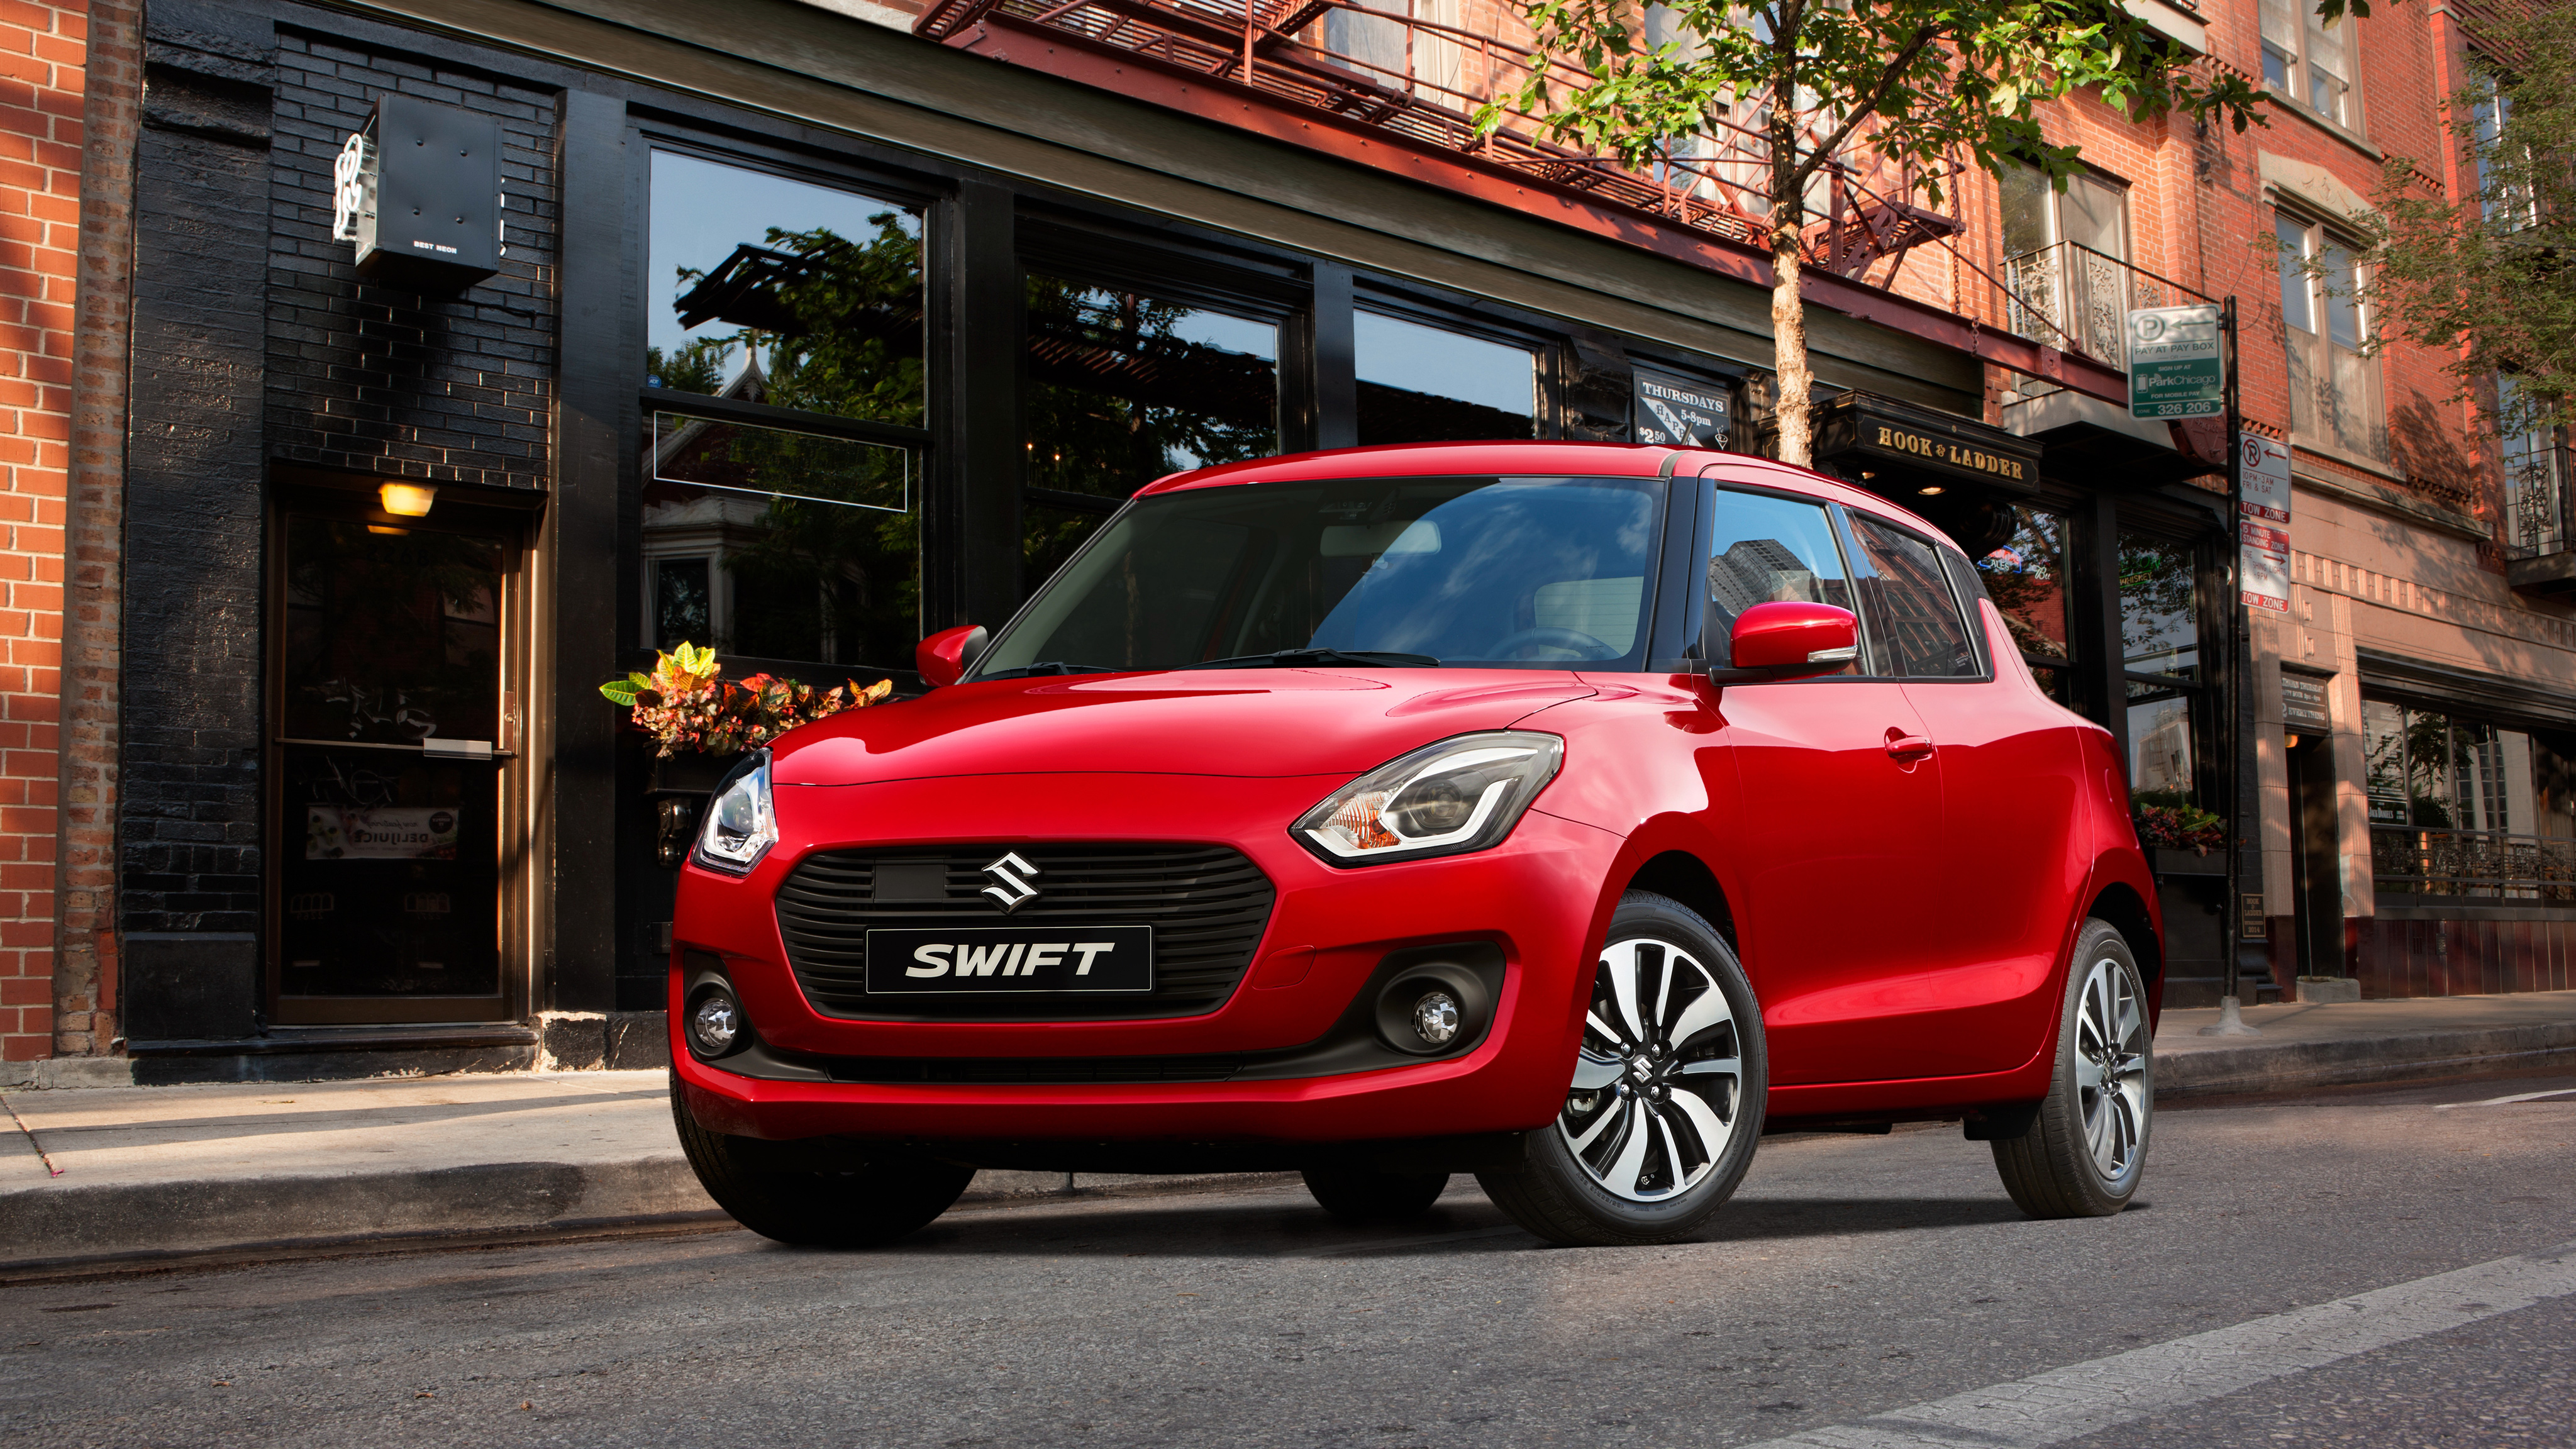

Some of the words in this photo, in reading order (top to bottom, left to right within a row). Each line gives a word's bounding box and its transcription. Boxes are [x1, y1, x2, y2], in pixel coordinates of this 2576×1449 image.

[414, 240, 434, 250] BEST
[436, 244, 457, 254] NEON
[2135, 347, 2153, 355] PAY
[2155, 345, 2167, 353] AT
[2170, 343, 2189, 352] PAY
[2192, 342, 2214, 351] BOX
[2148, 375, 2216, 387] ParkChicago
[1642, 382, 1724, 413] THURSDAYS
[2157, 403, 2182, 415] 326
[2185, 401, 2211, 413] 206
[1680, 409, 1712, 426] 5-8pm
[1878, 426, 1932, 457] HOOK
[1935, 443, 1946, 457] &
[1950, 445, 2023, 480] LADDER
[2243, 480, 2251, 490] FRI
[2254, 483, 2258, 492] &
[2261, 485, 2272, 495] SAT
[2243, 502, 2260, 516] TOW
[2264, 508, 2286, 523] ZONE
[2243, 525, 2248, 533] 15
[2251, 526, 2271, 540] MINUTE
[2243, 534, 2268, 548] STANDING
[2271, 541, 2285, 552] ZONE
[2243, 550, 2252, 559] USE
[1991, 559, 2009, 571] ALES
[2268, 567, 2286, 577] LIGHTS
[2119, 572, 2152, 586] WHISKEY
[2243, 592, 2259, 606] TOW
[2263, 596, 2284, 611] ZONE
[2299, 682, 2324, 694] THURSDAY
[2288, 707, 2325, 721] EVERYTHING
[905, 942, 1116, 978] SWIFT
